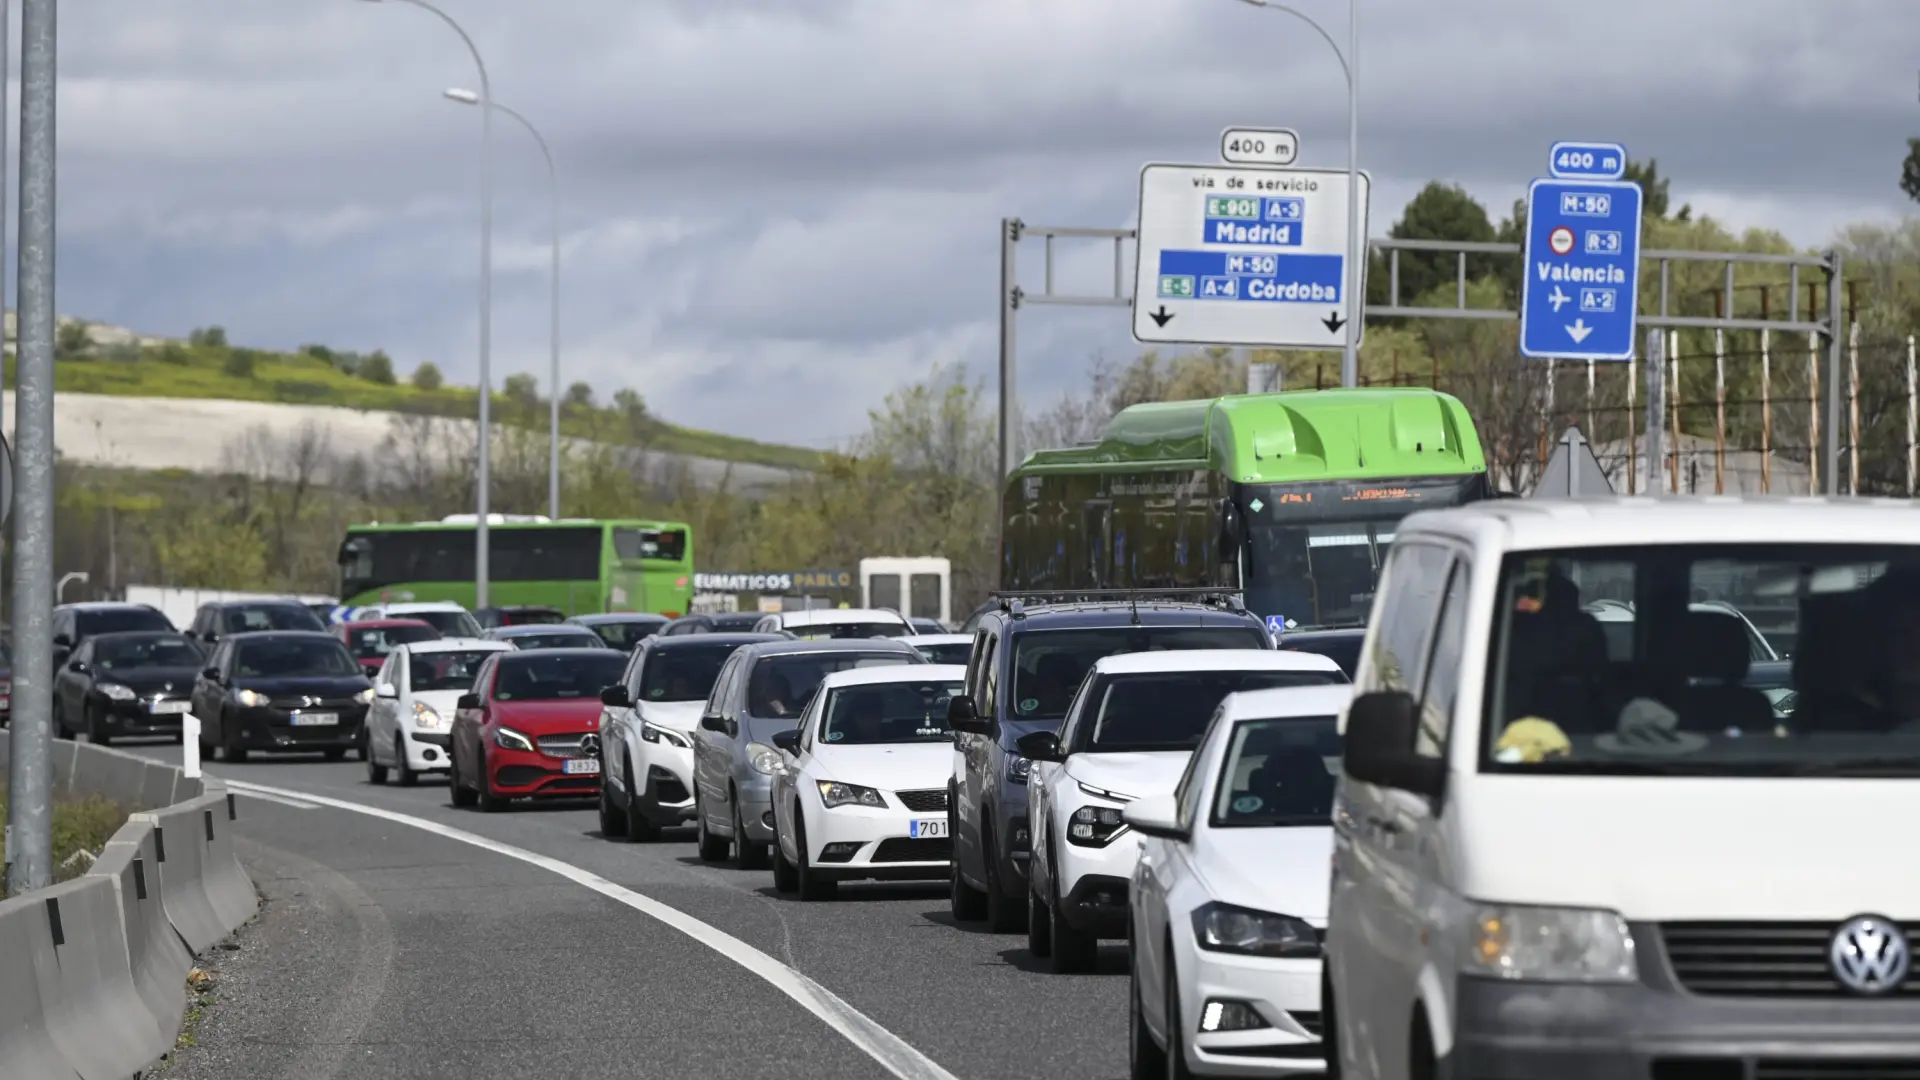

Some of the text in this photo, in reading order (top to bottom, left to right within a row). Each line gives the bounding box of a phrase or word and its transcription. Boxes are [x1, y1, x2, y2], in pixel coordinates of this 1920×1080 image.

[1229, 139, 1290, 155] 400 m
[1557, 152, 1617, 170] 400 m
[1226, 175, 1244, 189] de
[1257, 176, 1318, 192] servicio
[1208, 198, 1301, 218] E-901 A-3
[1563, 196, 1609, 213] M-50
[1216, 222, 1290, 244] Madrid
[1587, 233, 1618, 250] R-3
[1228, 257, 1275, 273] M-50
[1537, 261, 1626, 283] Valencia
[1162, 277, 1336, 300] E-5 A-4 Córdoba
[1584, 292, 1613, 309] A-2
[920, 821, 947, 836] 701
